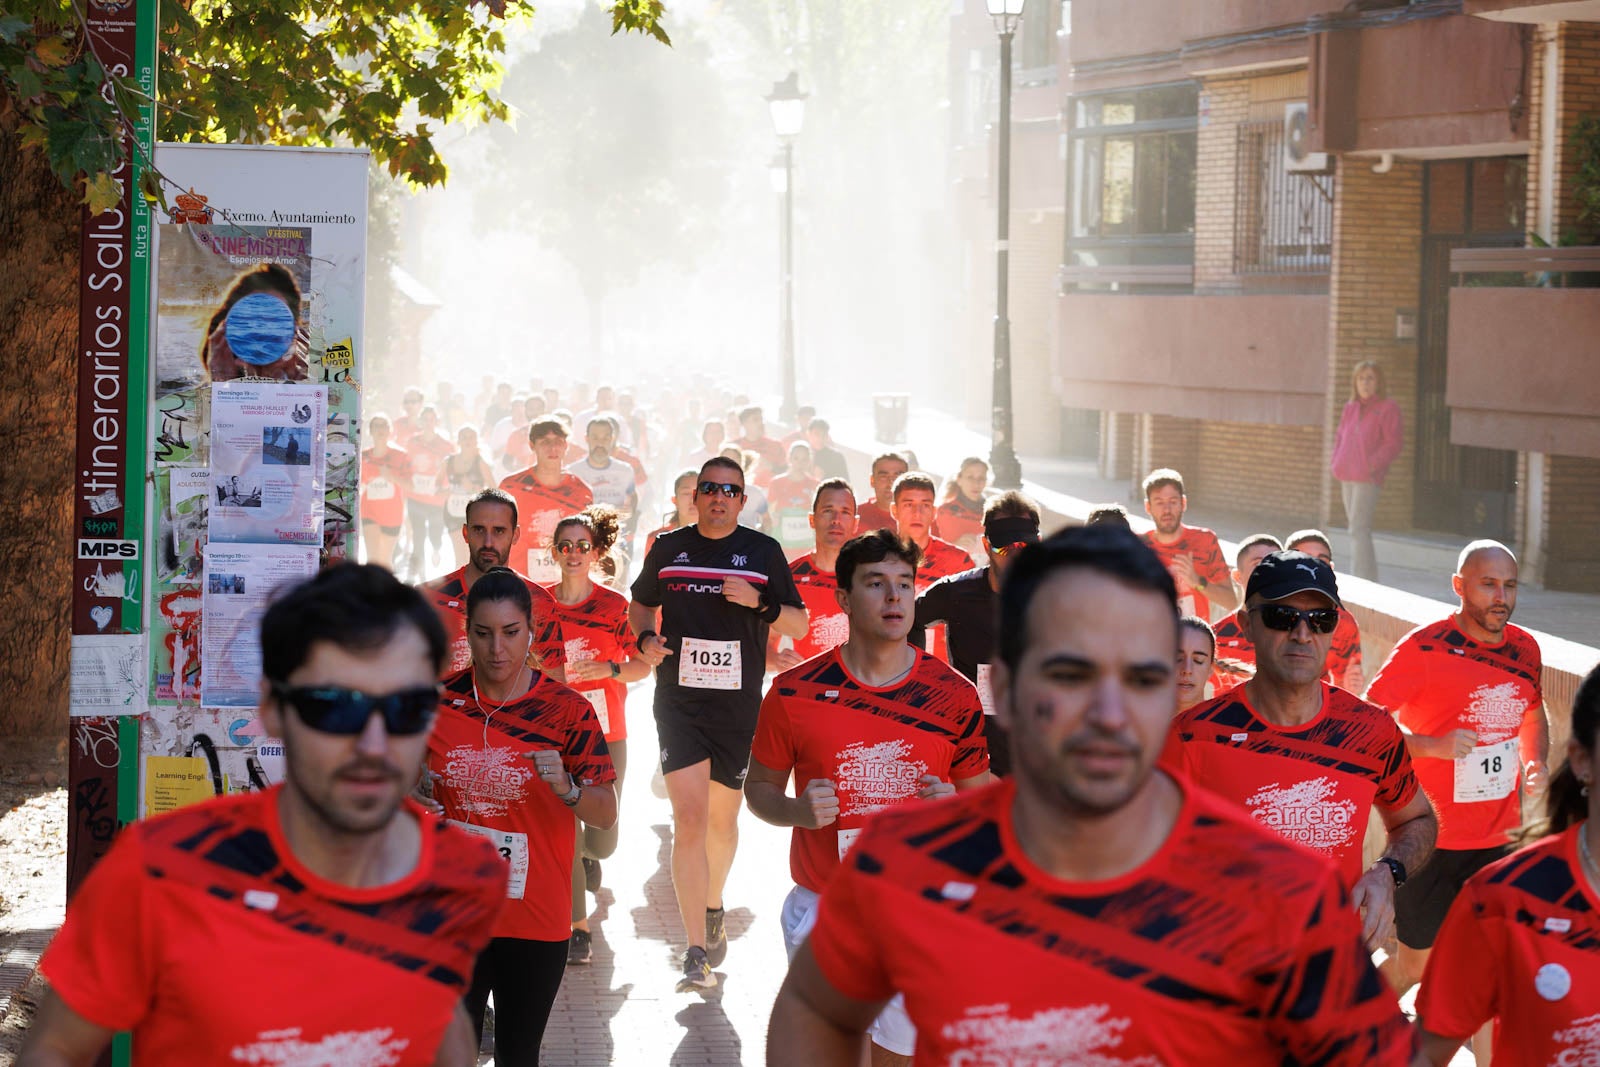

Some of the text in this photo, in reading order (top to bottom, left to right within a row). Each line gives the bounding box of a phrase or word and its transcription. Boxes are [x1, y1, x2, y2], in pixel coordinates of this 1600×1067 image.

[138, 66, 151, 108] cha
[137, 116, 150, 132] la
[222, 208, 356, 226] Excmo. Ayuntamiento
[135, 225, 146, 258] Ruta
[274, 229, 303, 239] FESTIVAL
[229, 255, 298, 265] Espejos de Amor
[81, 542, 136, 557] MPS
[813, 625, 849, 637] carre
[690, 649, 733, 667] 1032
[1470, 700, 1525, 713] carrera
[446, 761, 523, 785] carrera
[838, 761, 918, 779] carrera
[1480, 756, 1502, 774] 18
[156, 772, 187, 780] Learning
[839, 780, 917, 794] cruzroja.es
[1251, 806, 1348, 826] carrera
[1279, 827, 1349, 843] zroja.es
